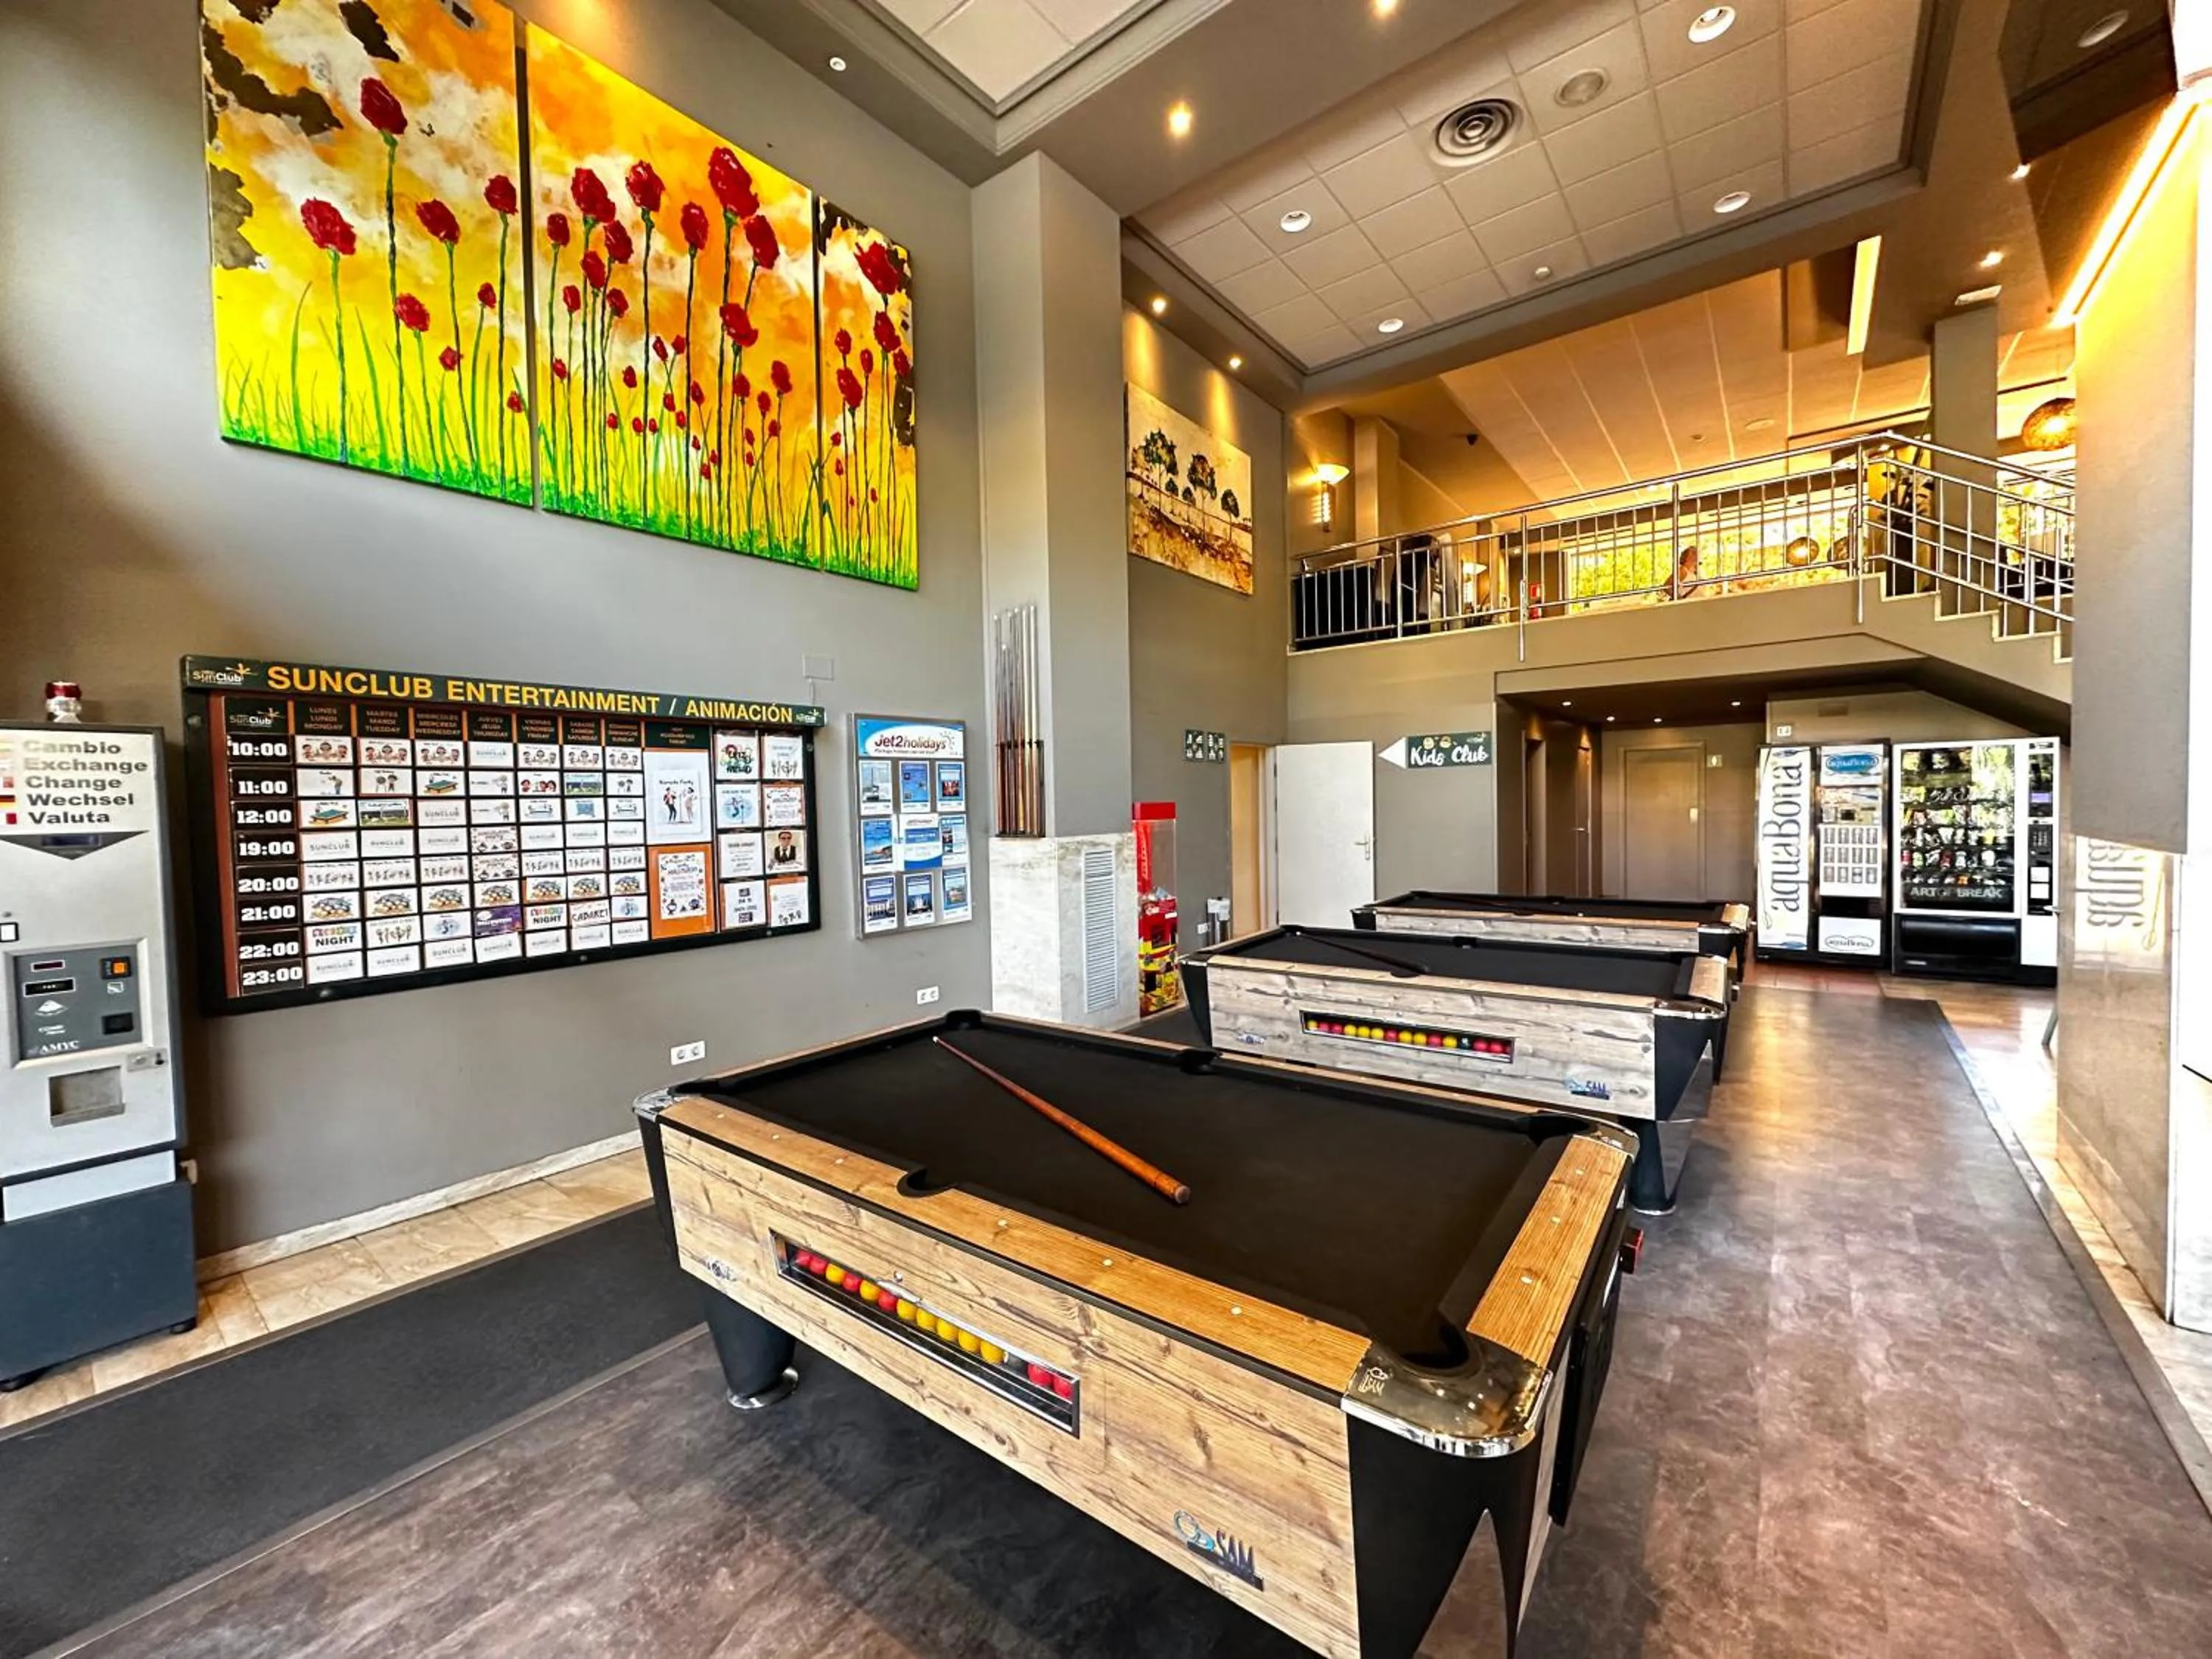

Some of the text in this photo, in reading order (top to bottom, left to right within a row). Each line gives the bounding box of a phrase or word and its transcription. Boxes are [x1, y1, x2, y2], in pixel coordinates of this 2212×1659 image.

[192, 669, 243, 683] SunClub
[267, 665, 793, 723] SUNCLUB ENTERTAINMENT / ANIMACIÓN
[229, 714, 273, 726] SunClub
[23, 740, 122, 754] Cambio
[232, 742, 288, 757] 10:00
[1410, 744, 1489, 766] Kids Club
[24, 758, 148, 773] Exchange
[26, 775, 122, 790] Change
[238, 780, 288, 794] 11:00
[27, 793, 134, 806] Wechsel
[28, 812, 111, 825] Valuta
[237, 810, 292, 824] 12:00
[1762, 762, 1809, 913] aquaBona
[239, 841, 295, 856] 19:00
[238, 877, 299, 893] 20:00
[1910, 887, 1936, 897] ART
[1957, 886, 2003, 898] BREAK
[241, 905, 296, 922] 21:00
[315, 935, 355, 947] NIGHT
[239, 942, 299, 959] 22:00
[243, 966, 303, 986] 23:00
[40, 1040, 80, 1054] AMYC
[1217, 1527, 1255, 1576] SAM
